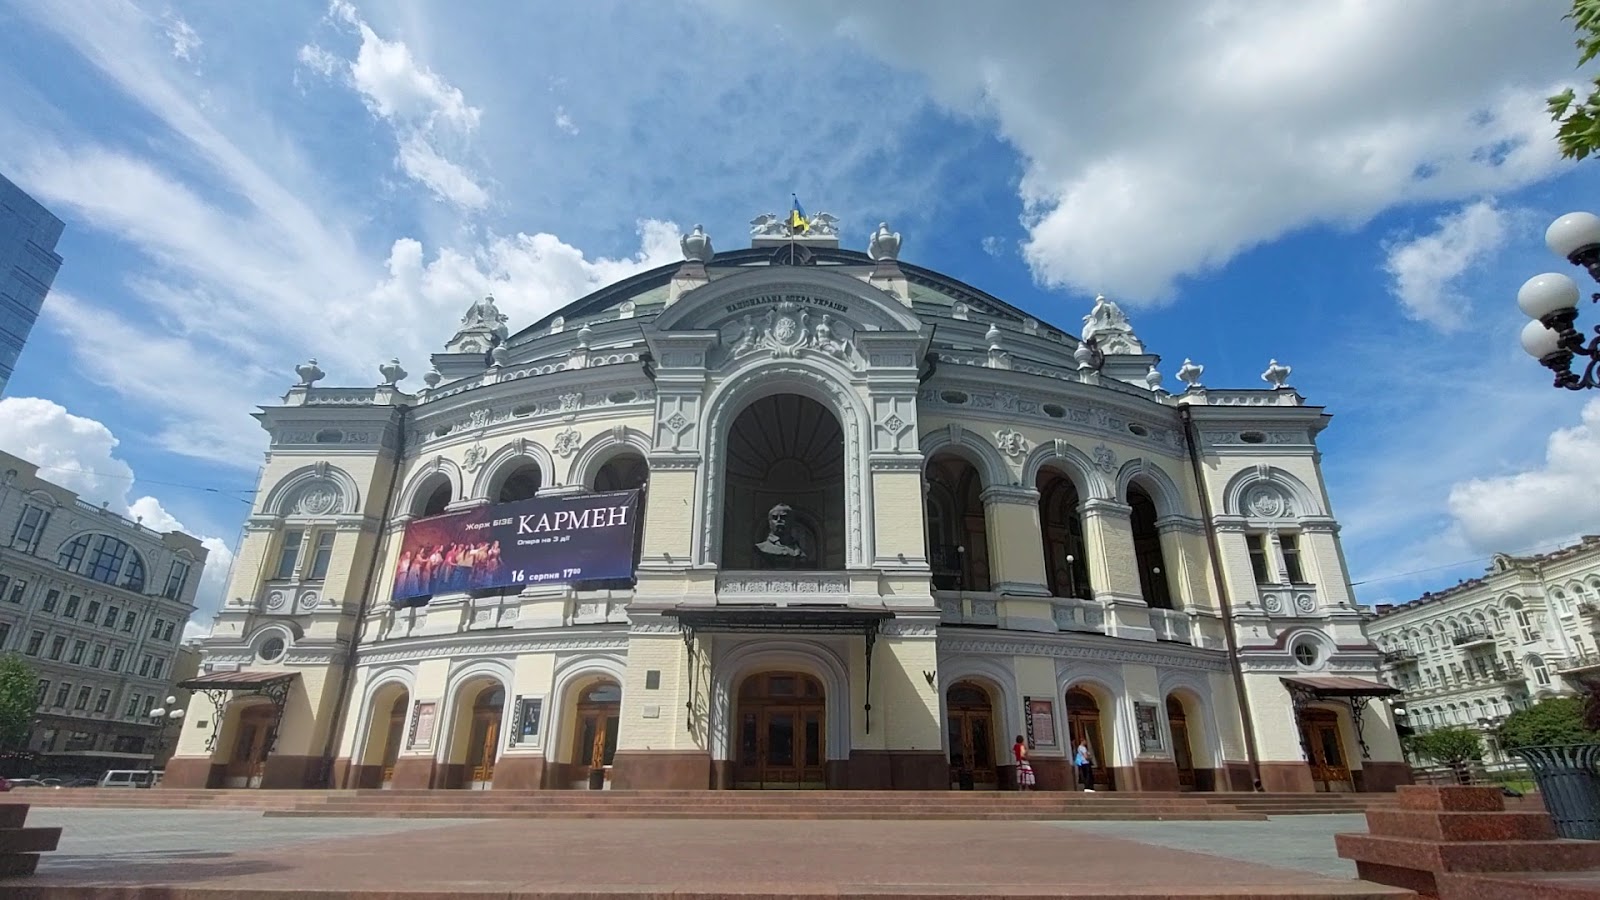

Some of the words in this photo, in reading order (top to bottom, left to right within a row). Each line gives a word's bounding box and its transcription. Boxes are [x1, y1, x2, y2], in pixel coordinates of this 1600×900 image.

[785, 295, 811, 304] ОПЕРА
[465, 523, 490, 531] Жорж
[493, 518, 514, 527] БІЗЕ
[517, 506, 629, 535] КАРМЕН
[560, 535, 571, 543] дії
[511, 569, 525, 583] 16
[529, 572, 560, 581] серпня
